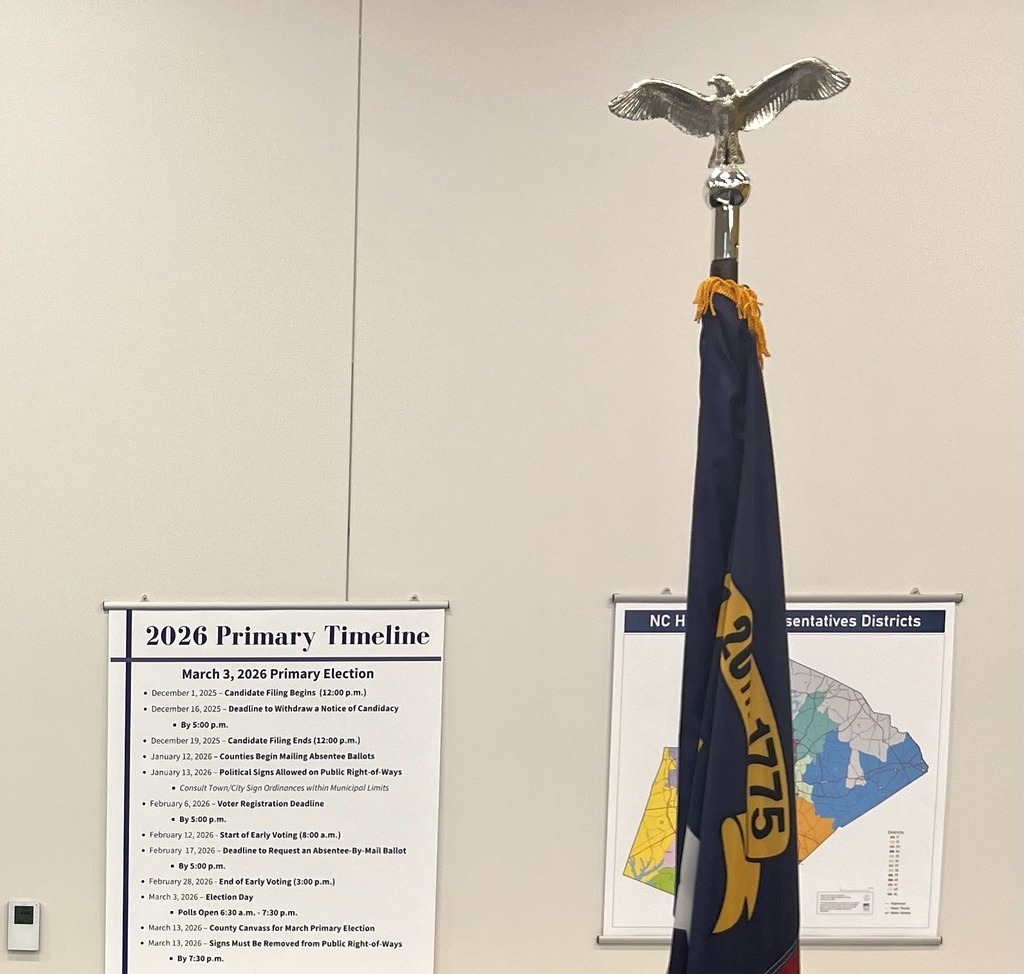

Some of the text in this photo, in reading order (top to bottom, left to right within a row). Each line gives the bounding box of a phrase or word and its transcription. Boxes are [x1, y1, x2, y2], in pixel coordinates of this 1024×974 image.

[650, 614, 671, 627] NC
[786, 614, 857, 627] sentatives
[861, 614, 921, 627] Districts
[146, 624, 430, 652] 2026 Primary Timeline
[182, 667, 374, 682] March 3, 2026 Primary Election
[151, 688, 367, 699] December 1, 2025 Candidate Filing Begins (12:00 p.m.)
[151, 705, 190, 713] December
[190, 705, 202, 714] 16,
[203, 705, 221, 713] 2025
[228, 704, 264, 713] Deadline
[264, 705, 274, 713] to
[274, 704, 313, 713] Withdraw
[320, 704, 347, 712] Notice
[347, 704, 357, 712] of
[357, 704, 399, 714] Candidacy
[150, 752, 375, 762] January 12, 2026 Counties Begin Mailing Absentee Ballots
[150, 769, 181, 778] January
[182, 768, 193, 777] 13,
[194, 768, 212, 776] 2026
[219, 768, 252, 776] Political
[253, 768, 275, 778] Signs
[275, 768, 308, 776] Allowed
[320, 768, 345, 776] Public
[346, 768, 403, 778] Right-of-Ways
[178, 908, 197, 916] Polls
[198, 908, 219, 918] Open
[261, 909, 279, 917] 7:30
[279, 910, 298, 918] p.m.
[173, 924, 183, 932] 13,
[184, 924, 203, 932] 2026
[209, 924, 238, 933] County
[238, 924, 271, 932] Canvass
[271, 924, 284, 932] for
[284, 924, 309, 932] March
[310, 924, 342, 934] Primary
[343, 924, 375, 932] Election
[148, 939, 171, 947] March
[172, 939, 183, 948] 13,
[184, 939, 202, 947] 2026
[209, 939, 231, 949] Signs
[263, 939, 300, 947] Removed
[301, 939, 320, 947] from
[321, 939, 346, 948] Public
[347, 939, 403, 949] Right-of-Ways
